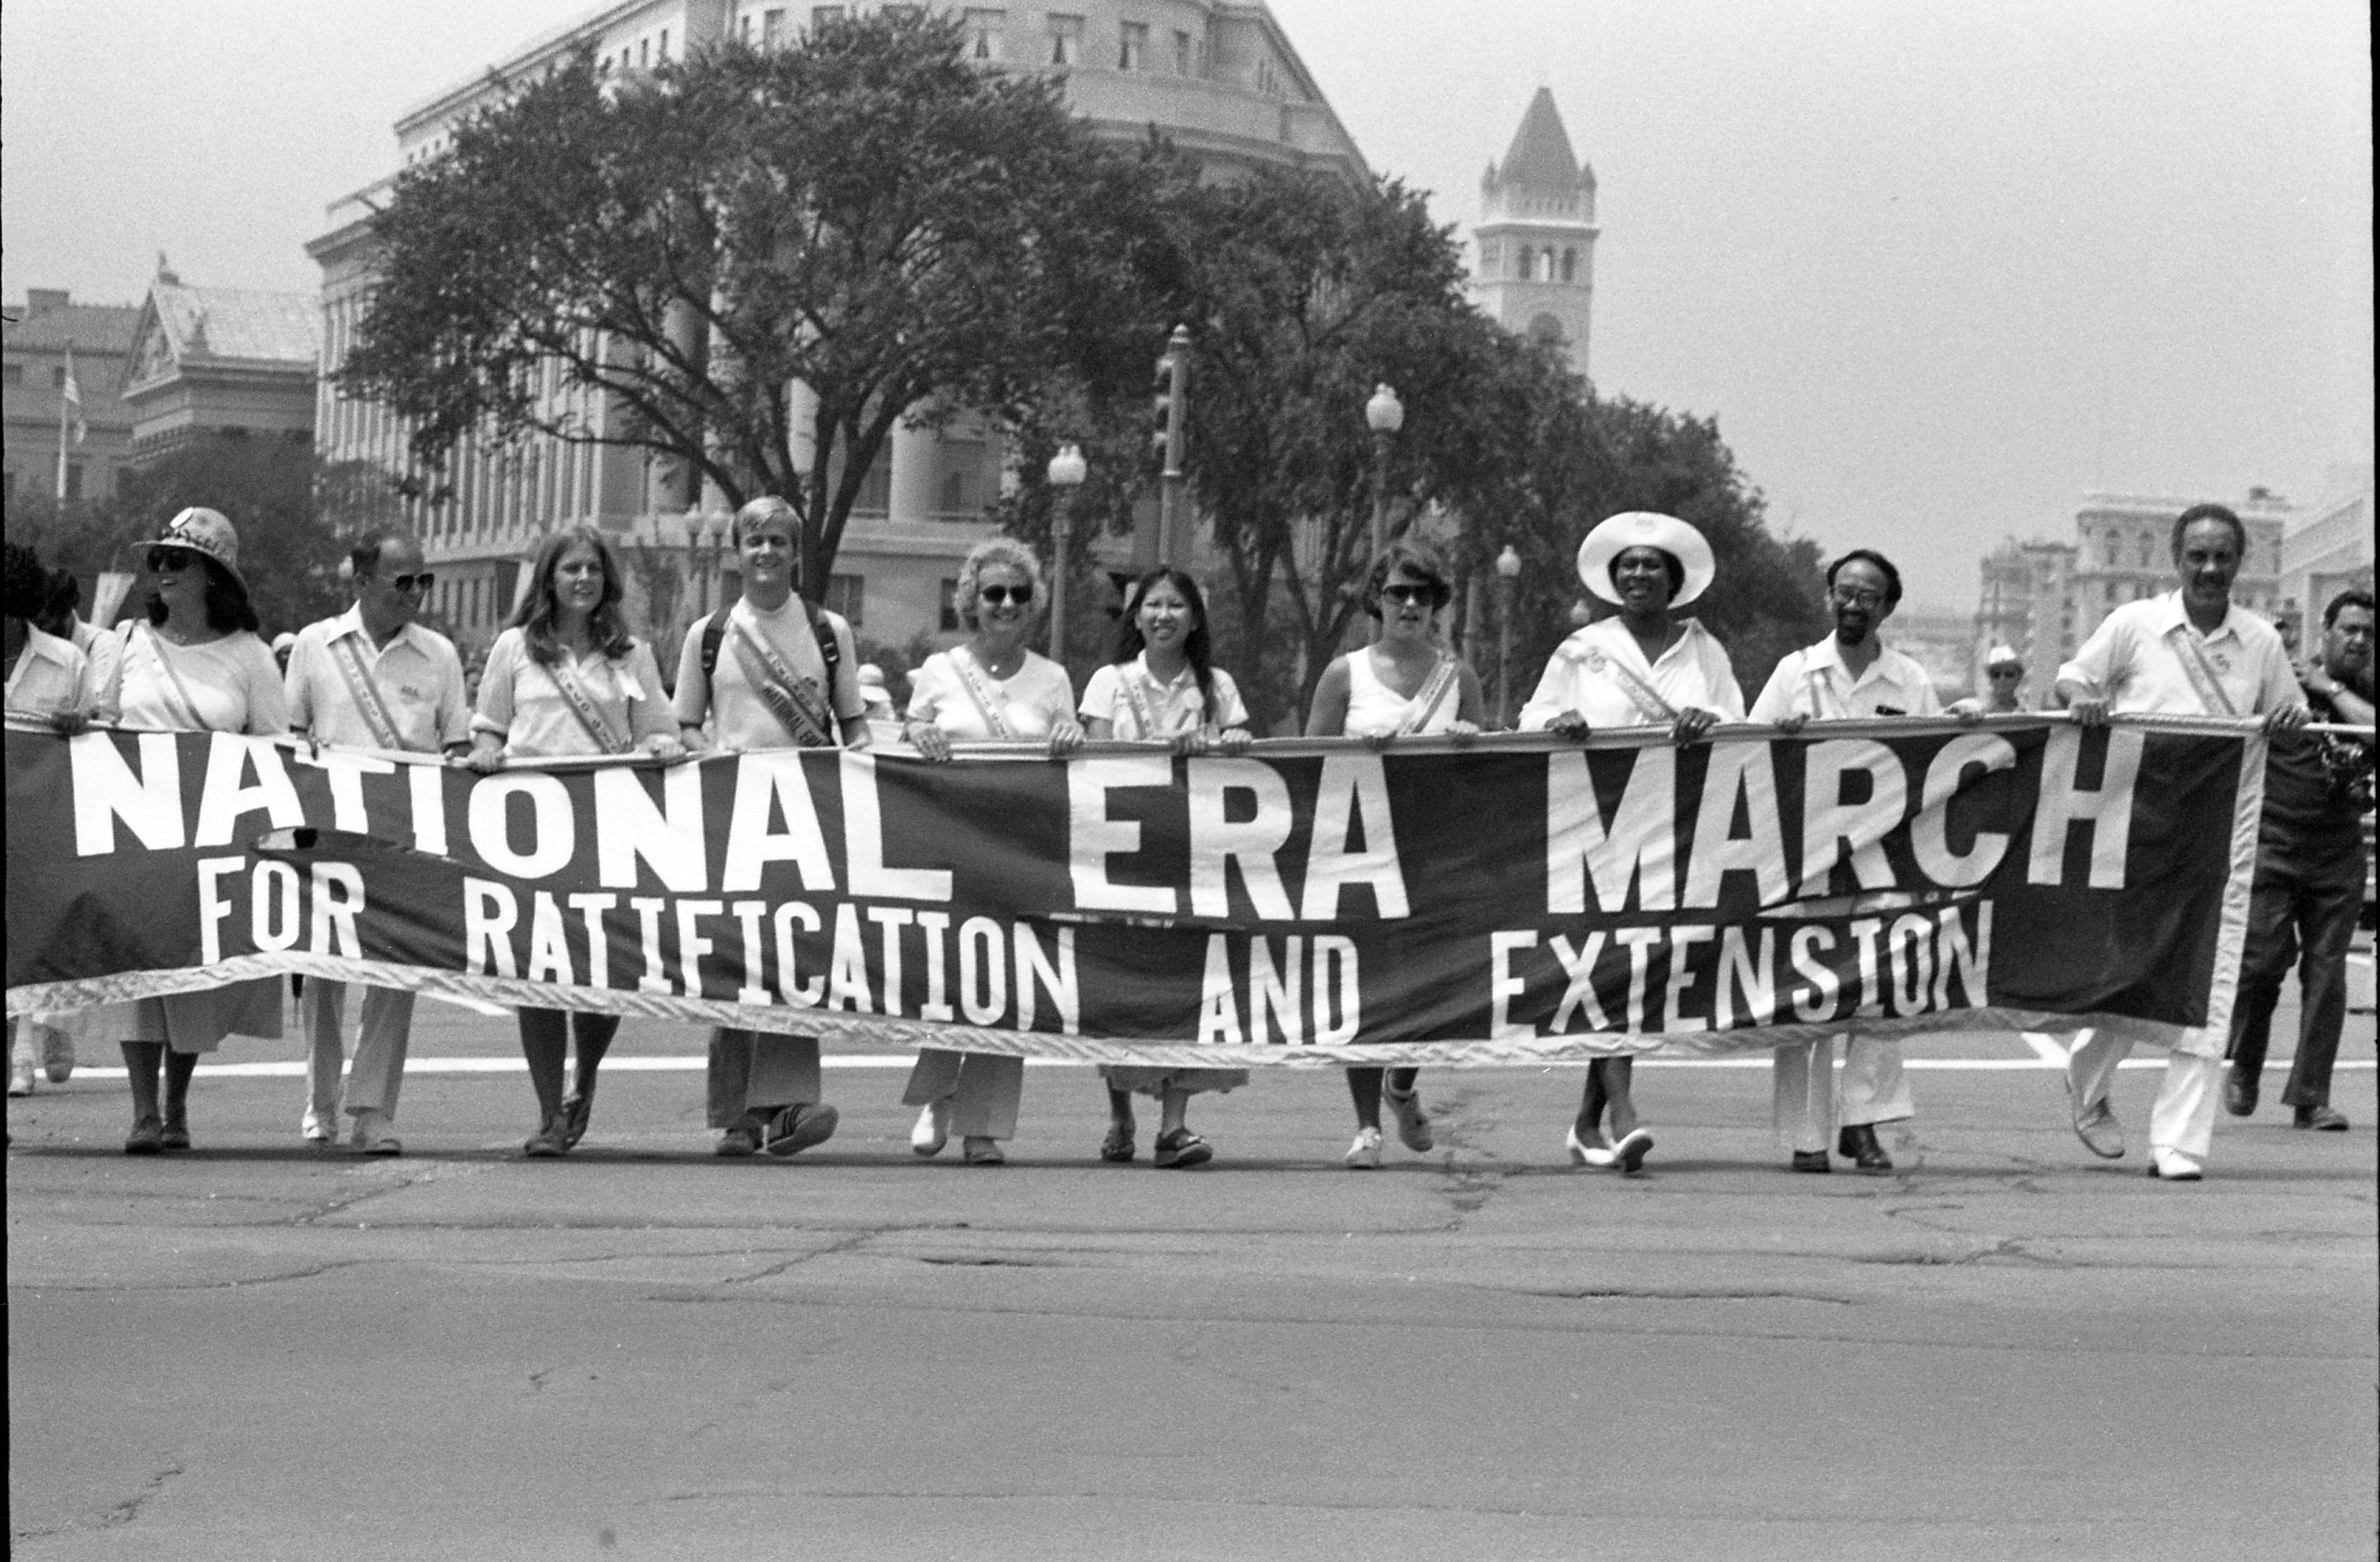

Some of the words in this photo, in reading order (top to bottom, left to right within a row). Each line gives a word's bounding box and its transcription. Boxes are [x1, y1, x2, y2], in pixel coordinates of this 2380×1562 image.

[70, 731, 953, 901] NATIONAL
[1068, 754, 1410, 920] ERA
[1548, 726, 2144, 913] MARCH
[198, 856, 365, 965] FOR
[463, 875, 1079, 1035] RATIFICATION
[1197, 933, 1360, 1045] AND
[1490, 899, 1994, 1040] EXTENSION
